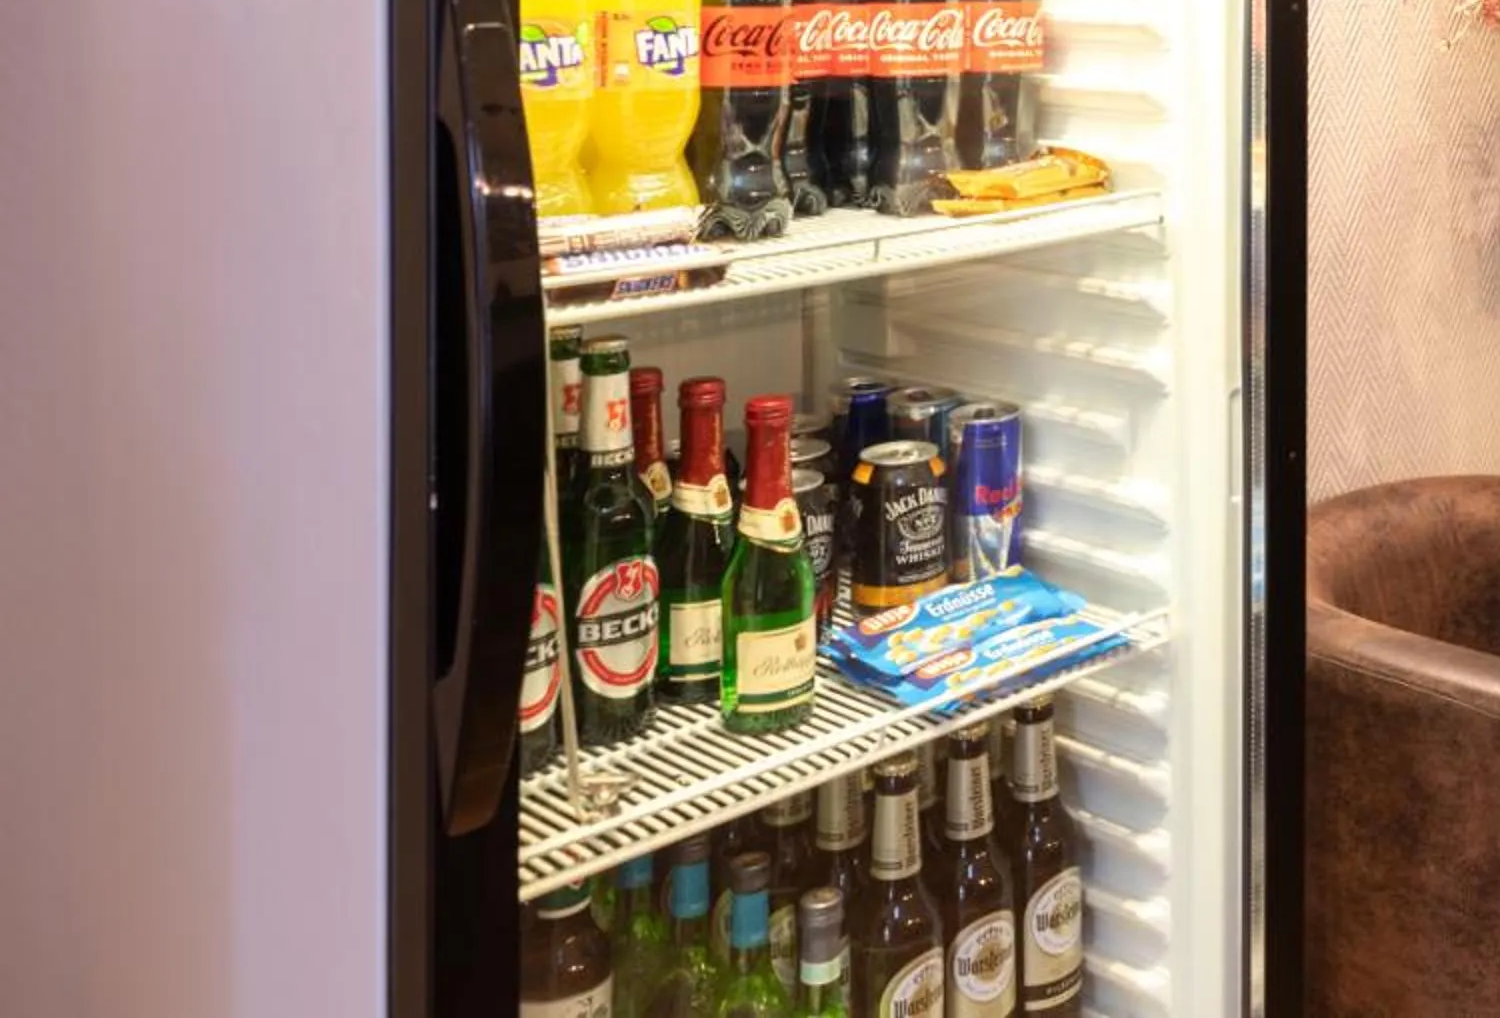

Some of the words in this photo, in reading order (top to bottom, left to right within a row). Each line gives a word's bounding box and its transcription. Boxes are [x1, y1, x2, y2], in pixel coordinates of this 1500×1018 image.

[520, 35, 583, 72] ANTA
[635, 26, 698, 65] FANT
[884, 493, 918, 522] JACK
[578, 601, 660, 644] BECK
